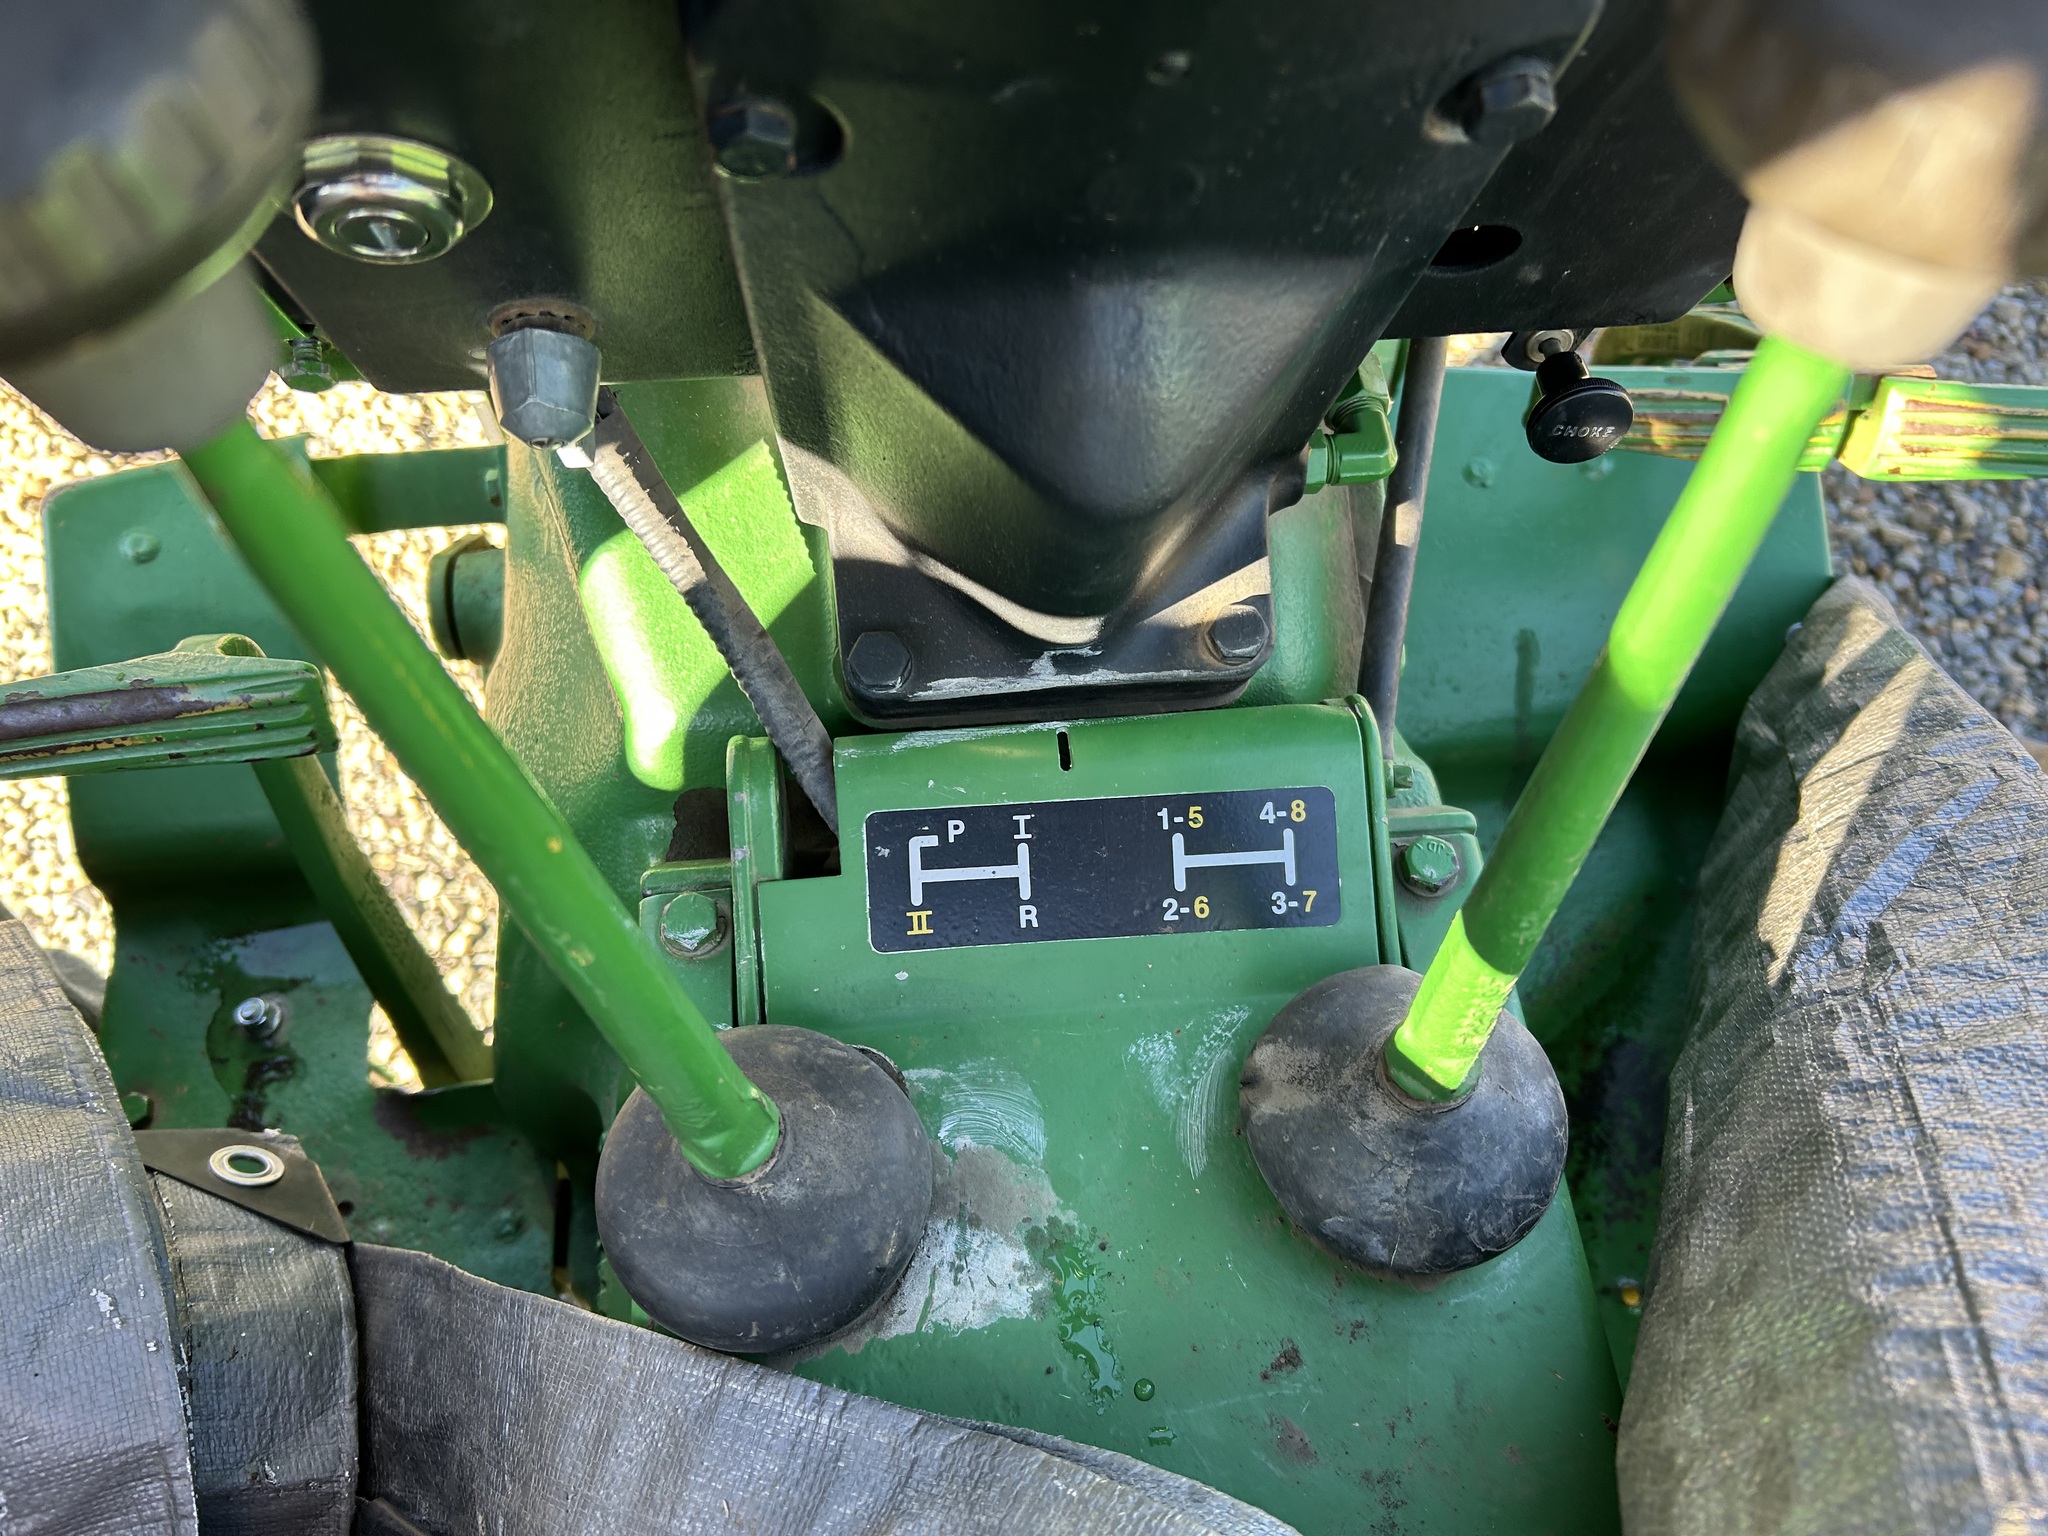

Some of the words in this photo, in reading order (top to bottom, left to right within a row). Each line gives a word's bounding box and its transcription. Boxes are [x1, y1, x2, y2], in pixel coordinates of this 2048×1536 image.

[1552, 425, 1615, 438] CHOKE
[1157, 806, 1204, 830] 1-5
[1259, 799, 1307, 824] 4-8
[948, 819, 965, 843] P
[1013, 814, 1032, 840] I
[1162, 895, 1210, 921] 2-6
[1271, 890, 1317, 915] 3-7
[906, 910, 934, 936] II
[1019, 904, 1039, 929] R
